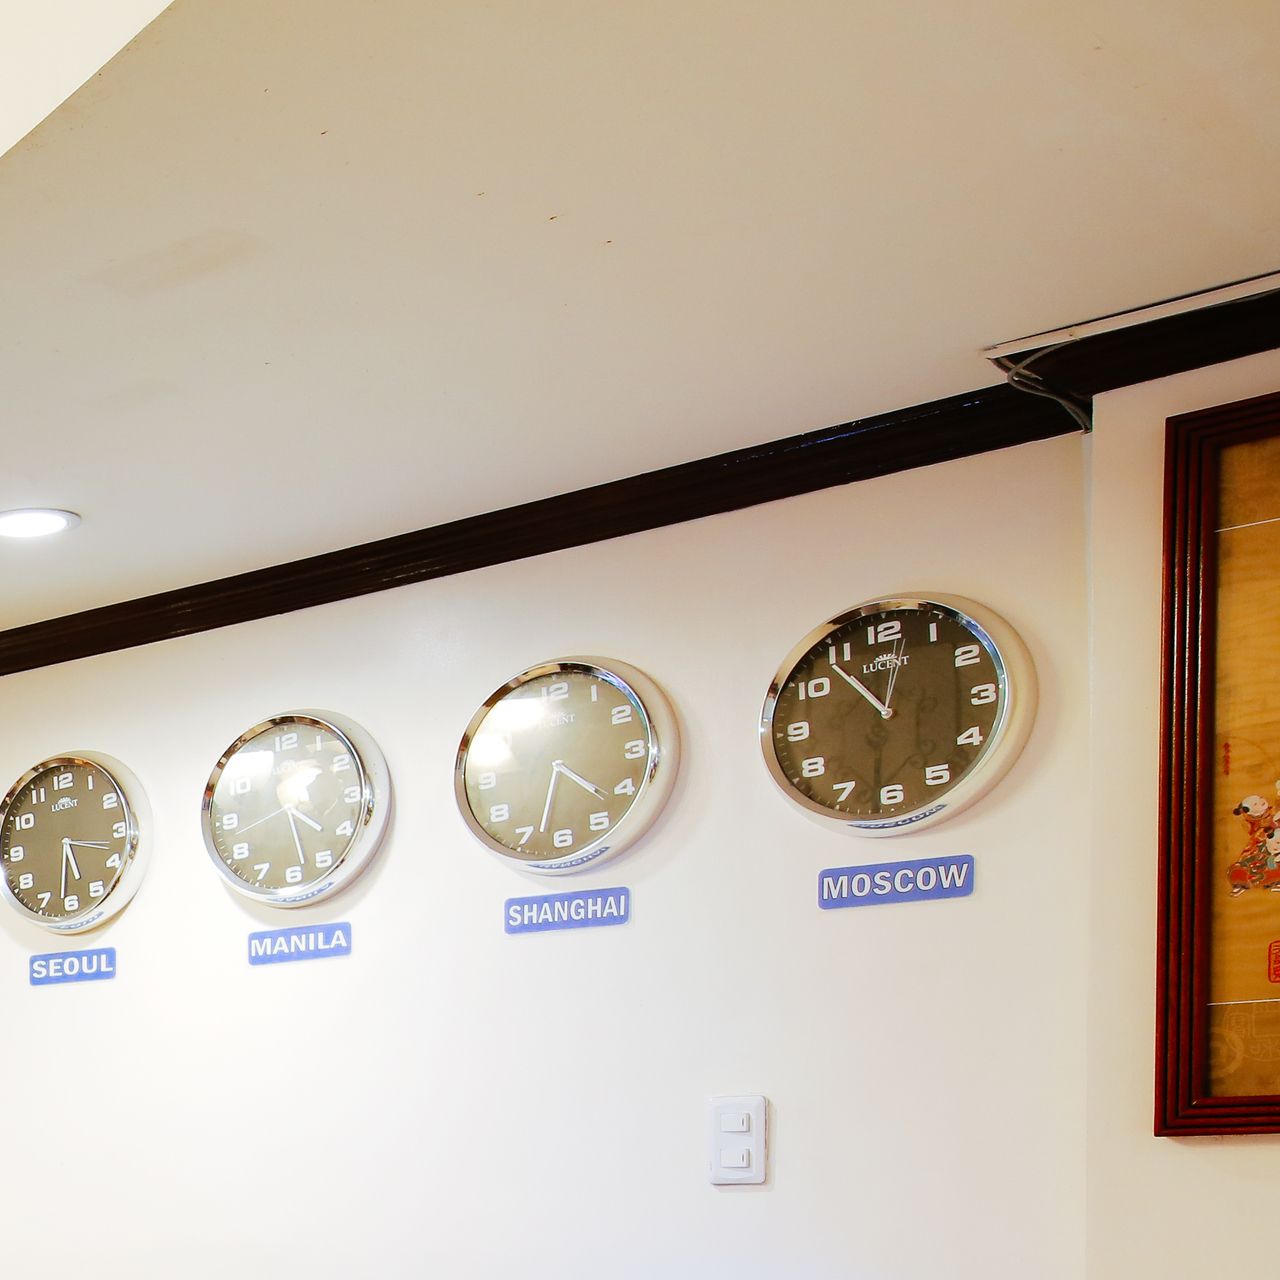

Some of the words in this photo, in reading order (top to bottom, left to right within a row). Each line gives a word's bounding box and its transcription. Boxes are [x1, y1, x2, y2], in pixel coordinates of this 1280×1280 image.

[867, 620, 901, 645] 12
[929, 622, 937, 642] 1
[829, 642, 850, 664] 11
[954, 644, 980, 667] 2
[863, 655, 909, 673] LUCENT
[591, 685, 597, 702] 1
[798, 677, 830, 700] 10
[971, 683, 996, 705] 3
[611, 704, 632, 725] 2
[787, 721, 810, 741] 9
[956, 726, 983, 746] 4
[275, 733, 298, 753] 12
[316, 735, 321, 750] 1
[625, 740, 645, 759] 3
[333, 754, 350, 772] 2
[801, 756, 824, 778] 8
[53, 773, 73, 790] 12
[88, 775, 93, 790] 1
[479, 772, 496, 790] 9
[924, 764, 950, 786] 5
[344, 786, 361, 803] 3
[614, 778, 635, 795] 4
[832, 781, 855, 802] 7
[880, 784, 904, 805] 6
[32, 788, 45, 804] 11
[103, 792, 118, 809] 2
[52, 799, 78, 812] LUCENT
[490, 803, 509, 823] 8
[15, 813, 34, 830] 10
[112, 821, 126, 838] 3
[222, 813, 238, 830] 9
[336, 820, 353, 836] 4
[590, 811, 609, 831] 5
[515, 826, 533, 844] 7
[553, 829, 573, 847] 6
[10, 846, 24, 862] 9
[233, 843, 249, 860] 8
[316, 851, 333, 868] 5
[106, 854, 121, 869] 4
[254, 863, 269, 880] 7
[285, 866, 302, 883] 6
[19, 873, 34, 890] 8
[89, 881, 104, 898] 5
[822, 863, 969, 900] MOSCOW
[37, 892, 52, 908] 7
[64, 895, 78, 911] 6
[509, 895, 626, 926] SHANGHAI
[251, 930, 347, 956] MANILA
[32, 954, 113, 978] SEOUL
